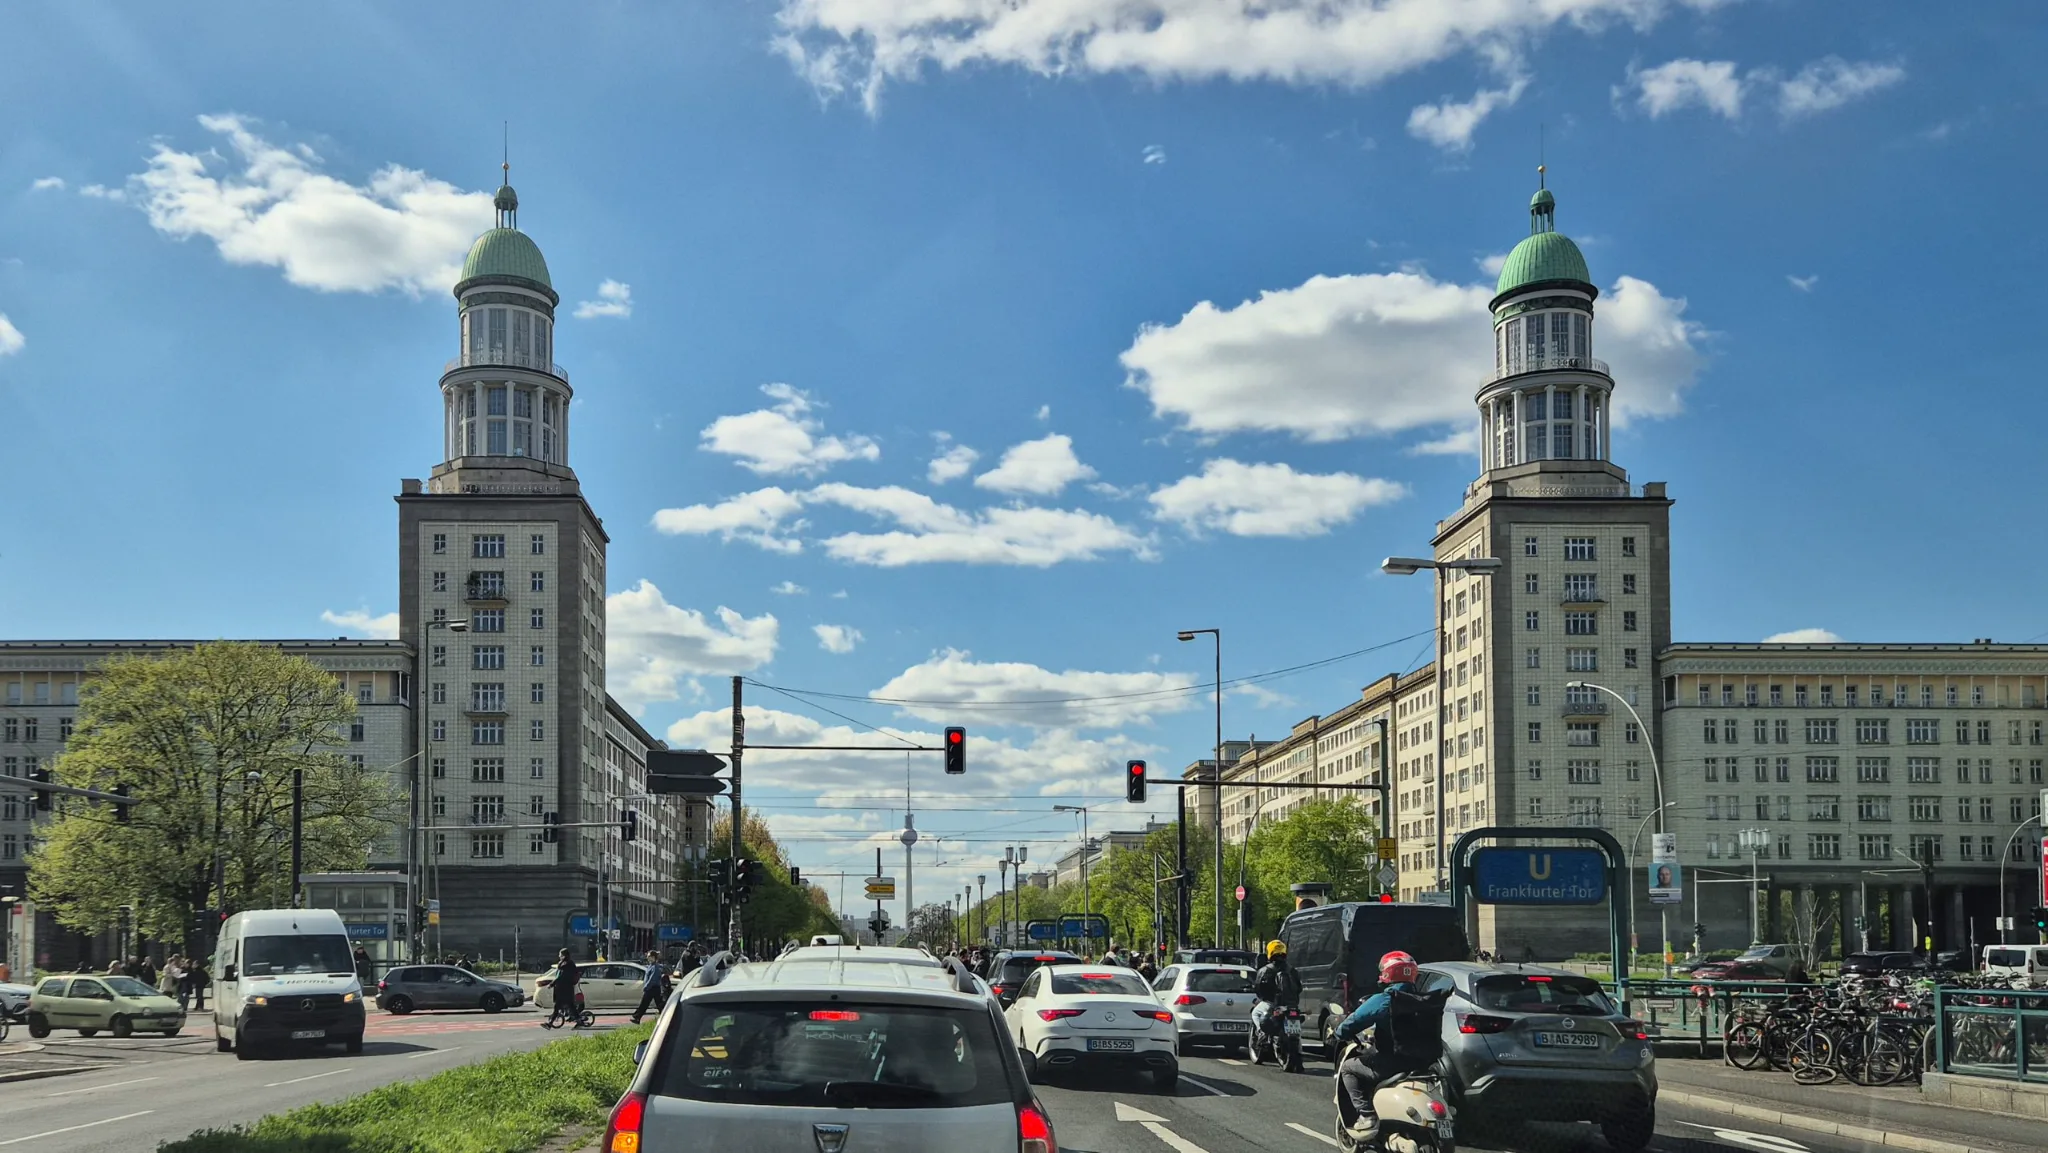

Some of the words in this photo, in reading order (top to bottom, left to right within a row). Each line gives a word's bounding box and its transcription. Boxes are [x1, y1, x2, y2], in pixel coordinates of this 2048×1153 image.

[1529, 854, 1551, 880] U
[1488, 884, 1566, 898] Frankfurter
[1571, 885, 1593, 898] Tor
[373, 927, 385, 935] Tor
[671, 927, 678, 935] U
[1572, 1034, 1597, 1046] 2989
